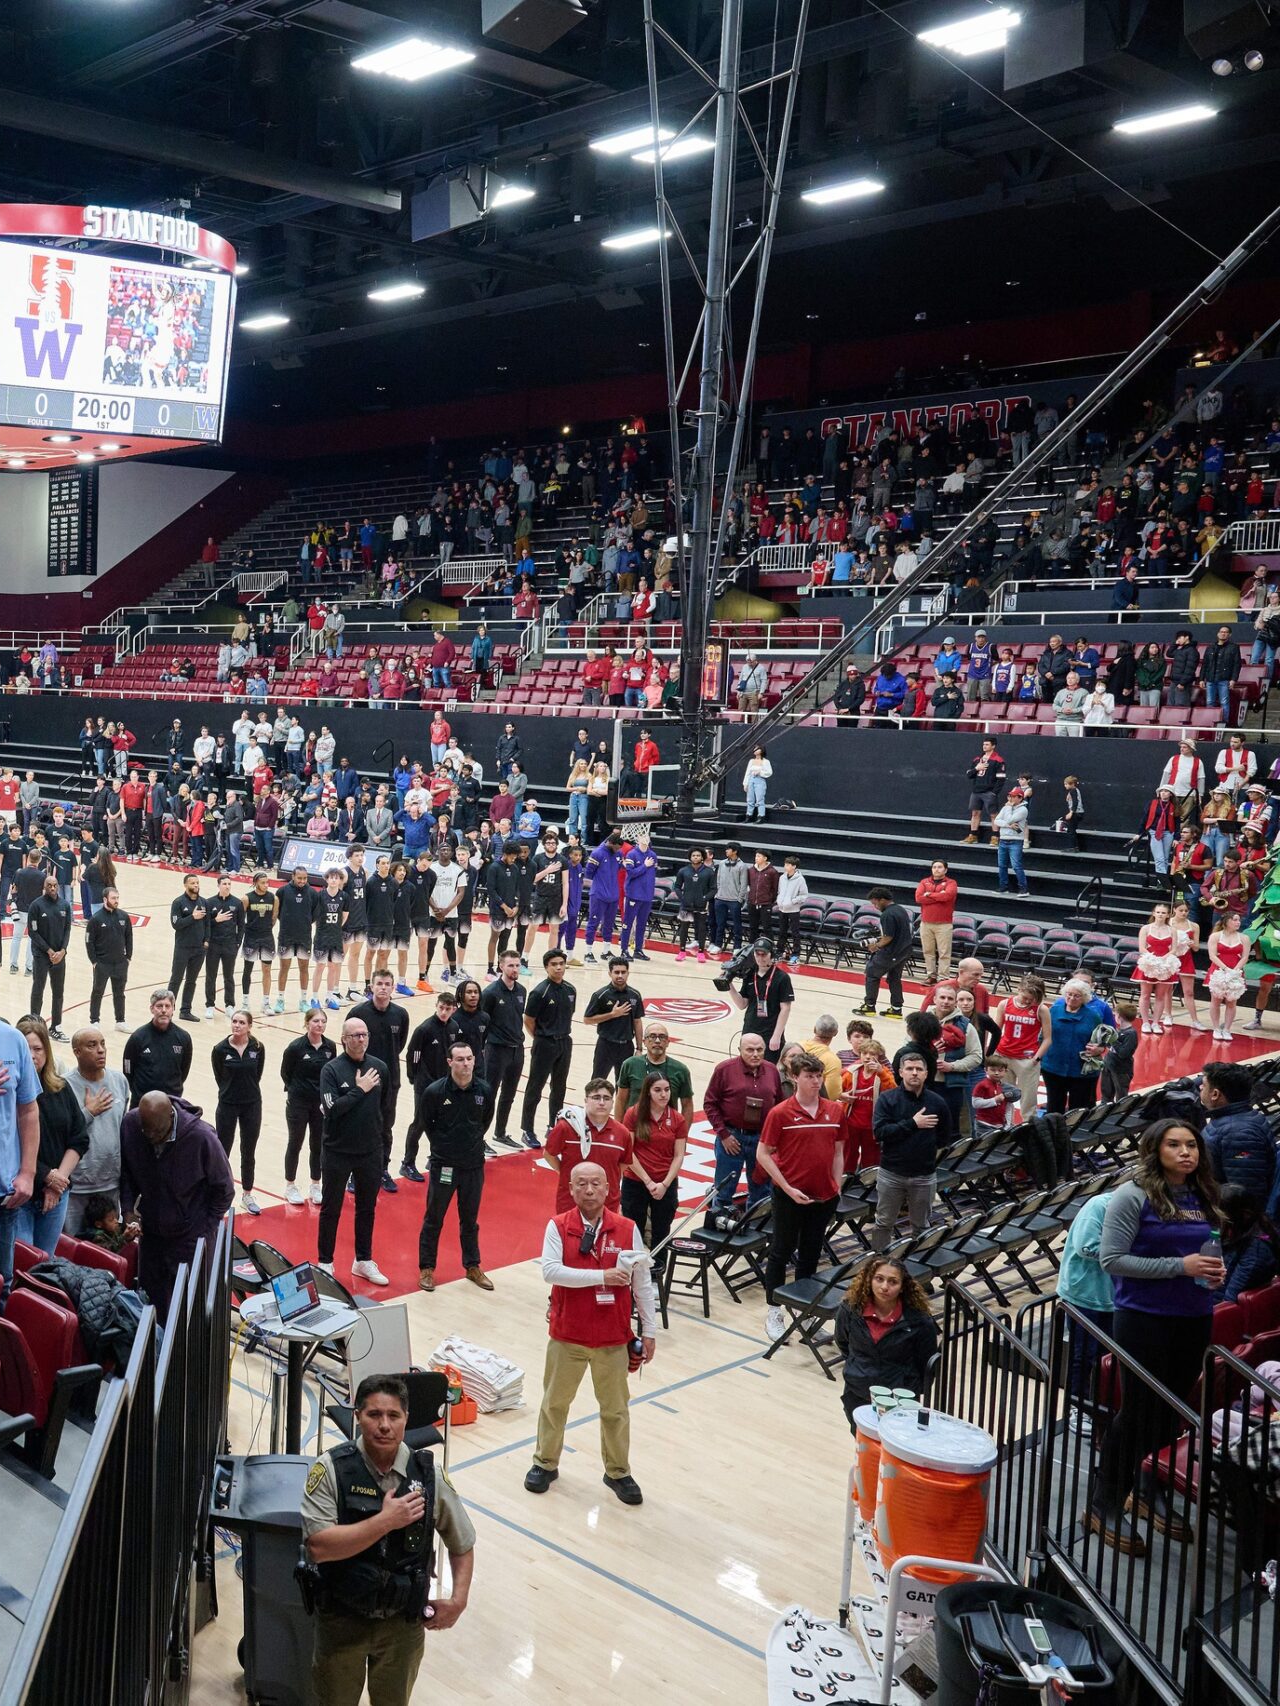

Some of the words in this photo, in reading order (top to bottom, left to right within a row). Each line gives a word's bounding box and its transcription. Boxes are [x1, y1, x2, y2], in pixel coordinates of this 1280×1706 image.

[83, 205, 199, 249] STANFORD
[15, 317, 83, 380] W
[35, 393, 48, 415] 0
[77, 398, 131, 420] 20:00
[158, 405, 170, 425] 0
[28, 417, 48, 426] FOULS
[97, 422, 110, 430] 1ST
[151, 428, 168, 437] FOULS
[1006, 597, 1014, 606] 10
[974, 659, 981, 668] 3
[4, 785, 11, 795] S
[308, 848, 315, 859] 0
[353, 888, 364, 899] 34
[326, 913, 338, 924] 33
[1004, 1013, 1036, 1025] TORCH
[1013, 1024, 1022, 1038] 8
[906, 1591, 936, 1603] GAT
